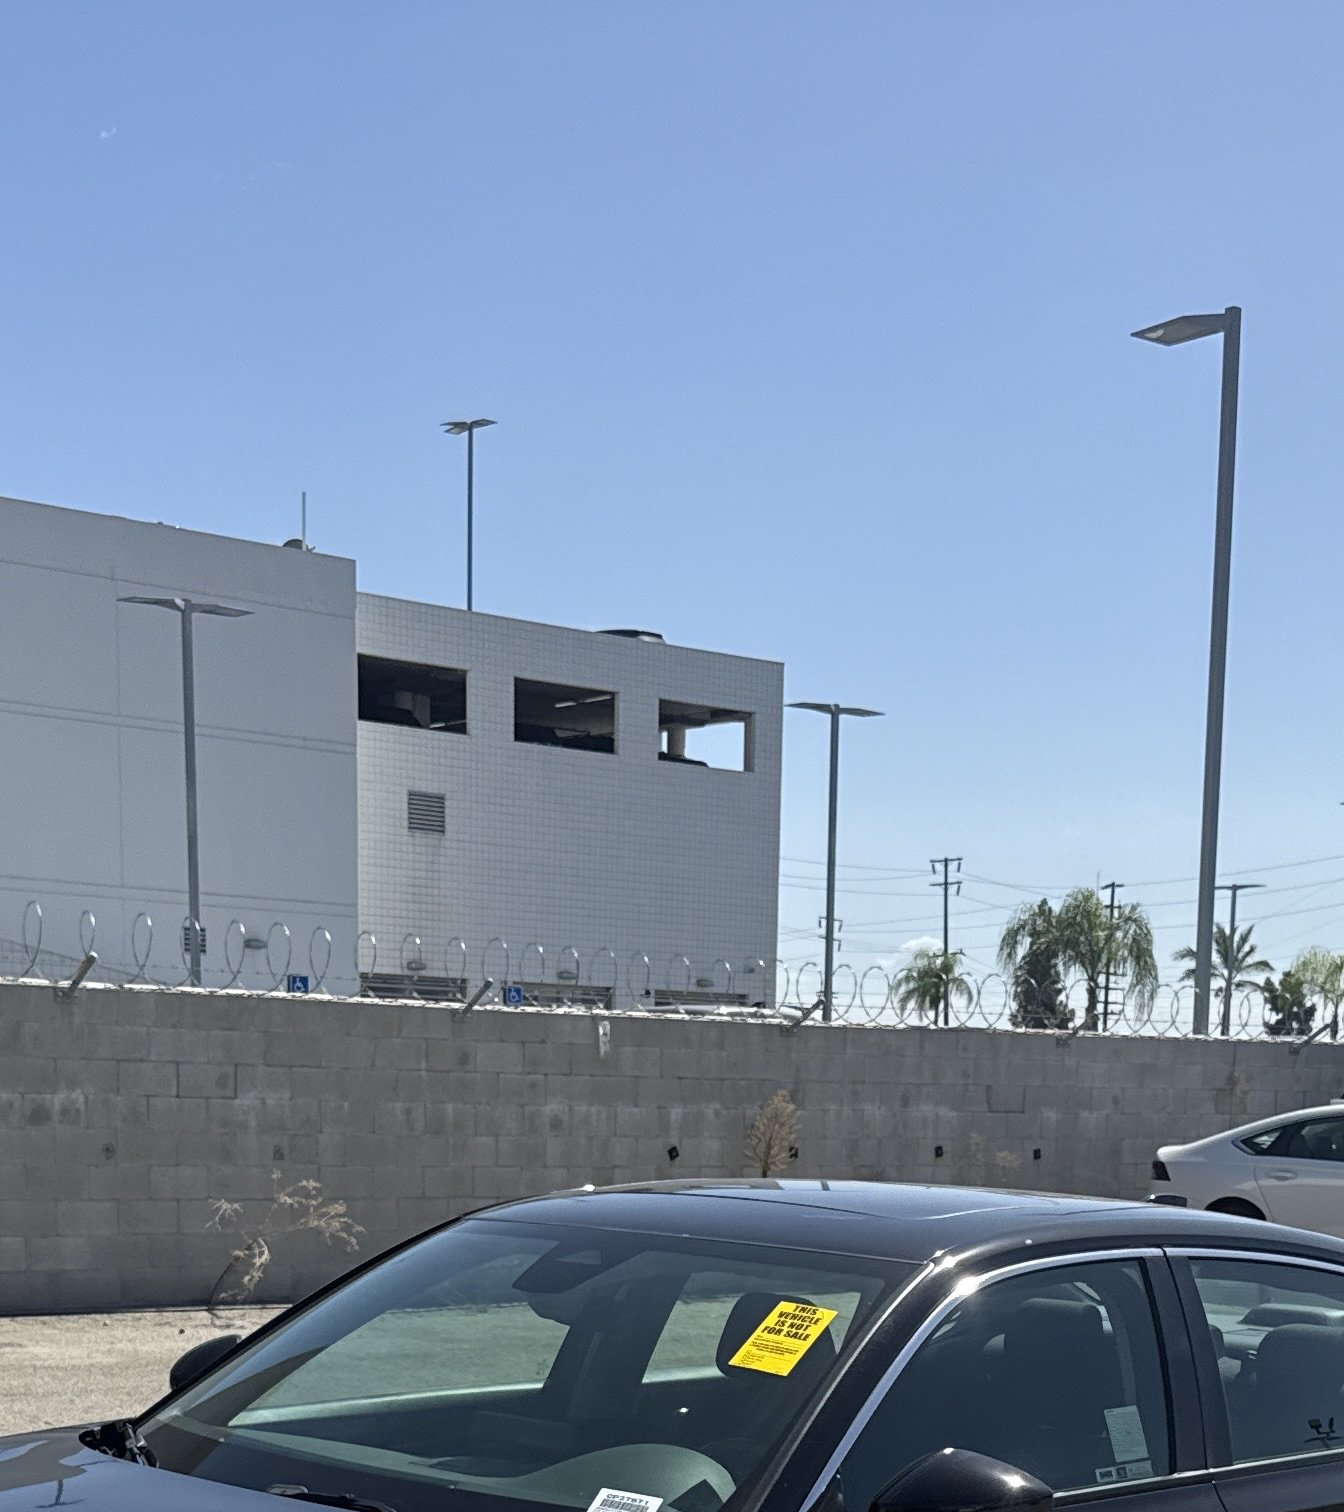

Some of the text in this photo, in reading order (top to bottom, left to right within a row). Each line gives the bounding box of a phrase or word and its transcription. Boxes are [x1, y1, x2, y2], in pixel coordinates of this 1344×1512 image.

[793, 1304, 820, 1316] THIS
[777, 1311, 823, 1325] VEHICLE
[774, 1319, 813, 1332] IS NOT
[760, 1325, 812, 1341] FOR SALE
